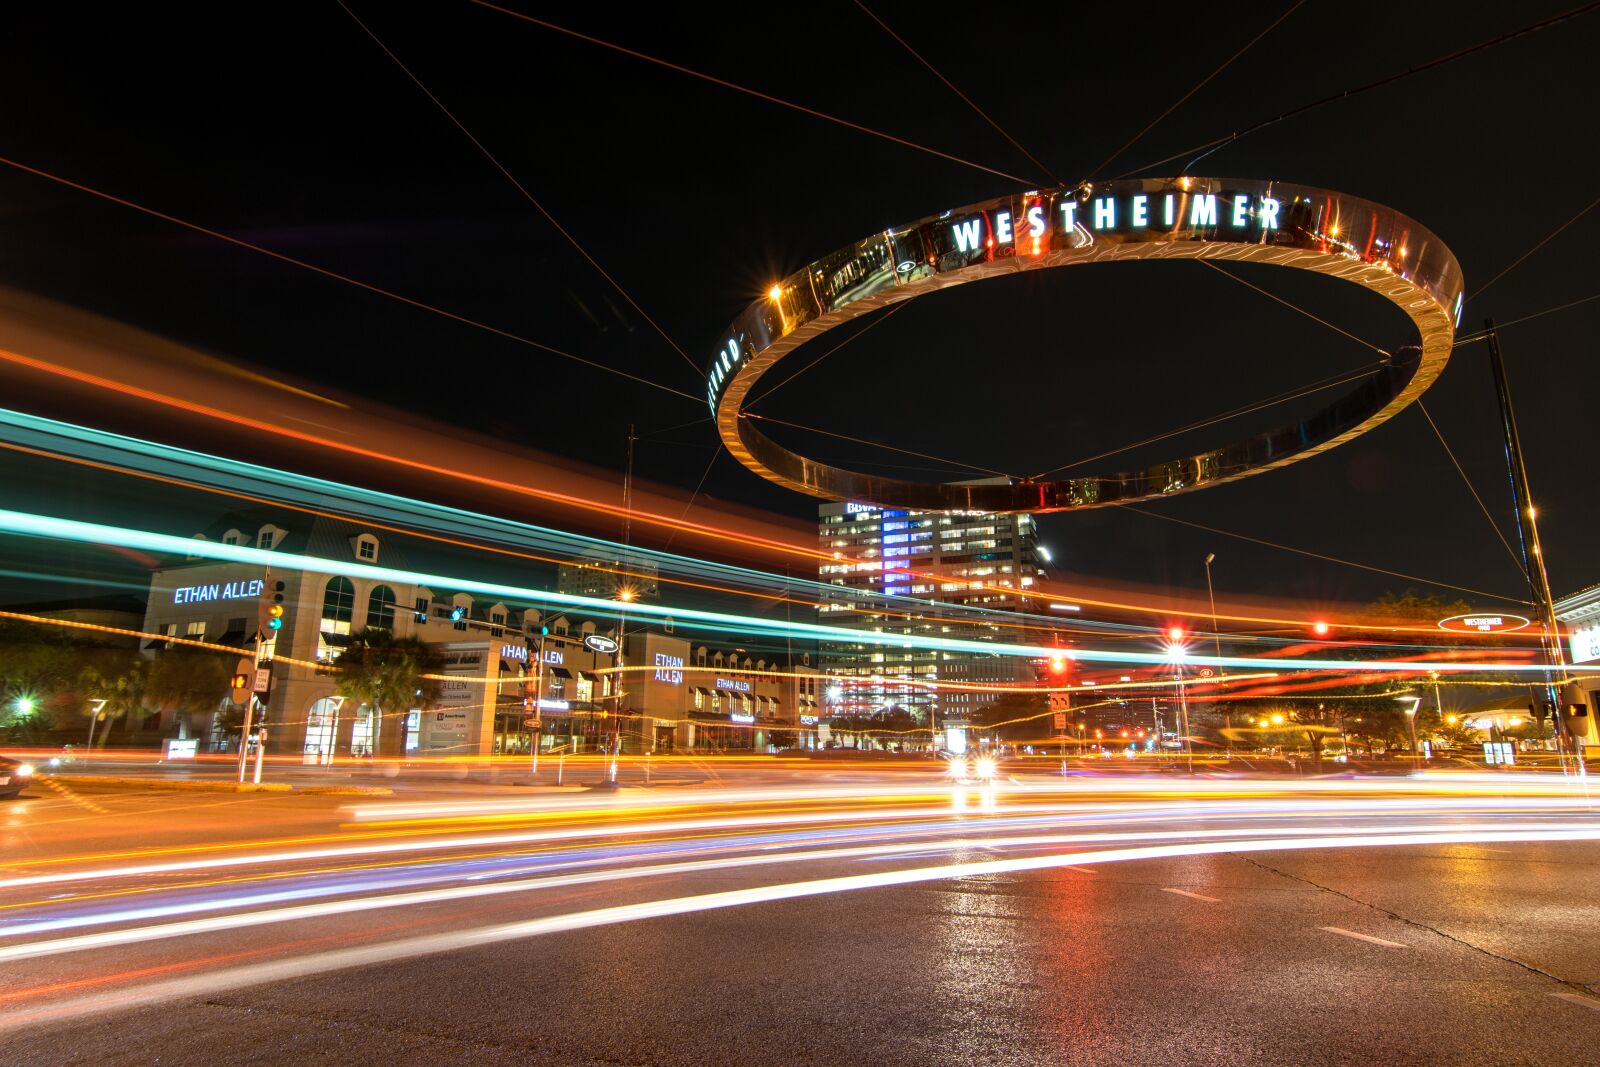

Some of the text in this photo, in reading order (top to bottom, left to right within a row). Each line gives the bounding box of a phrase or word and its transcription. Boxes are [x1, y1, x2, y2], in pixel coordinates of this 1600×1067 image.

[953, 194, 1279, 252] WESTHEIMER
[174, 584, 219, 604] ETHAN
[655, 653, 684, 668] ETHAN
[654, 668, 683, 684] ALLEN
[716, 678, 750, 692] ETHAN ALLEN
